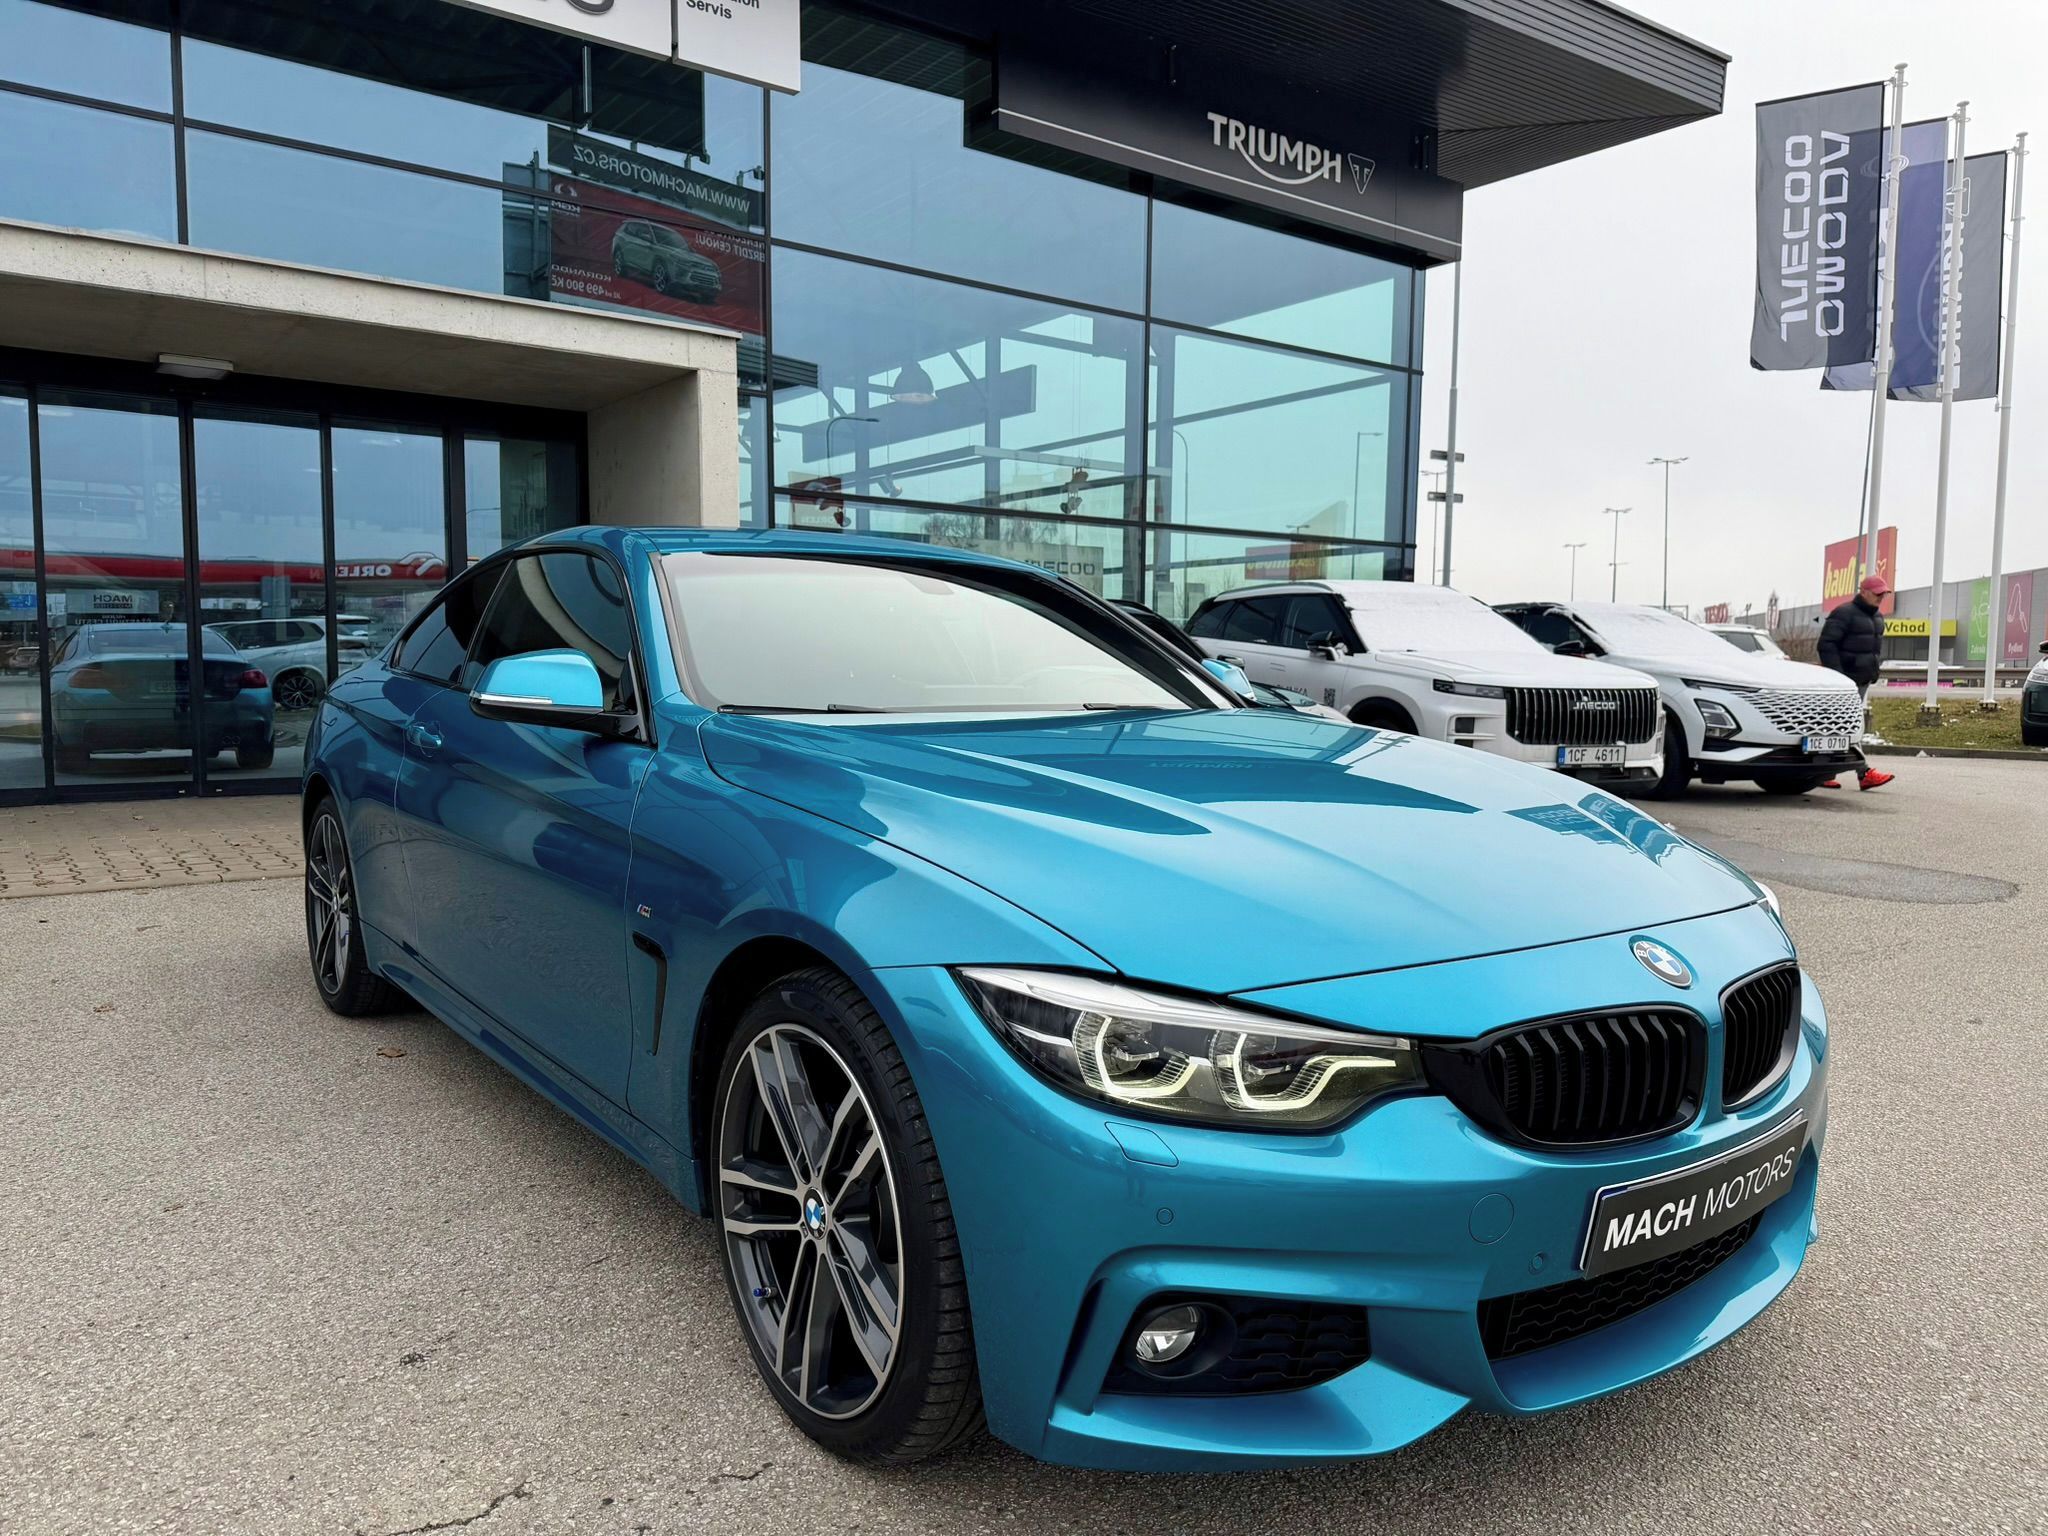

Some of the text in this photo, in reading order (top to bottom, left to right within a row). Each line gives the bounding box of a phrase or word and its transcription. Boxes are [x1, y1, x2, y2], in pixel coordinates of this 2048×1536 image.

[686, 0, 732, 19] Servis
[1207, 111, 1342, 184] TRIUMPH
[1885, 622, 1925, 632] Vchod
[1573, 702, 1615, 710] JAECOO
[1828, 738, 1846, 748] 0710
[1568, 749, 1587, 762] 1CF
[1594, 749, 1620, 761] 4611
[1603, 1146, 1796, 1252] MACH MOTORS
